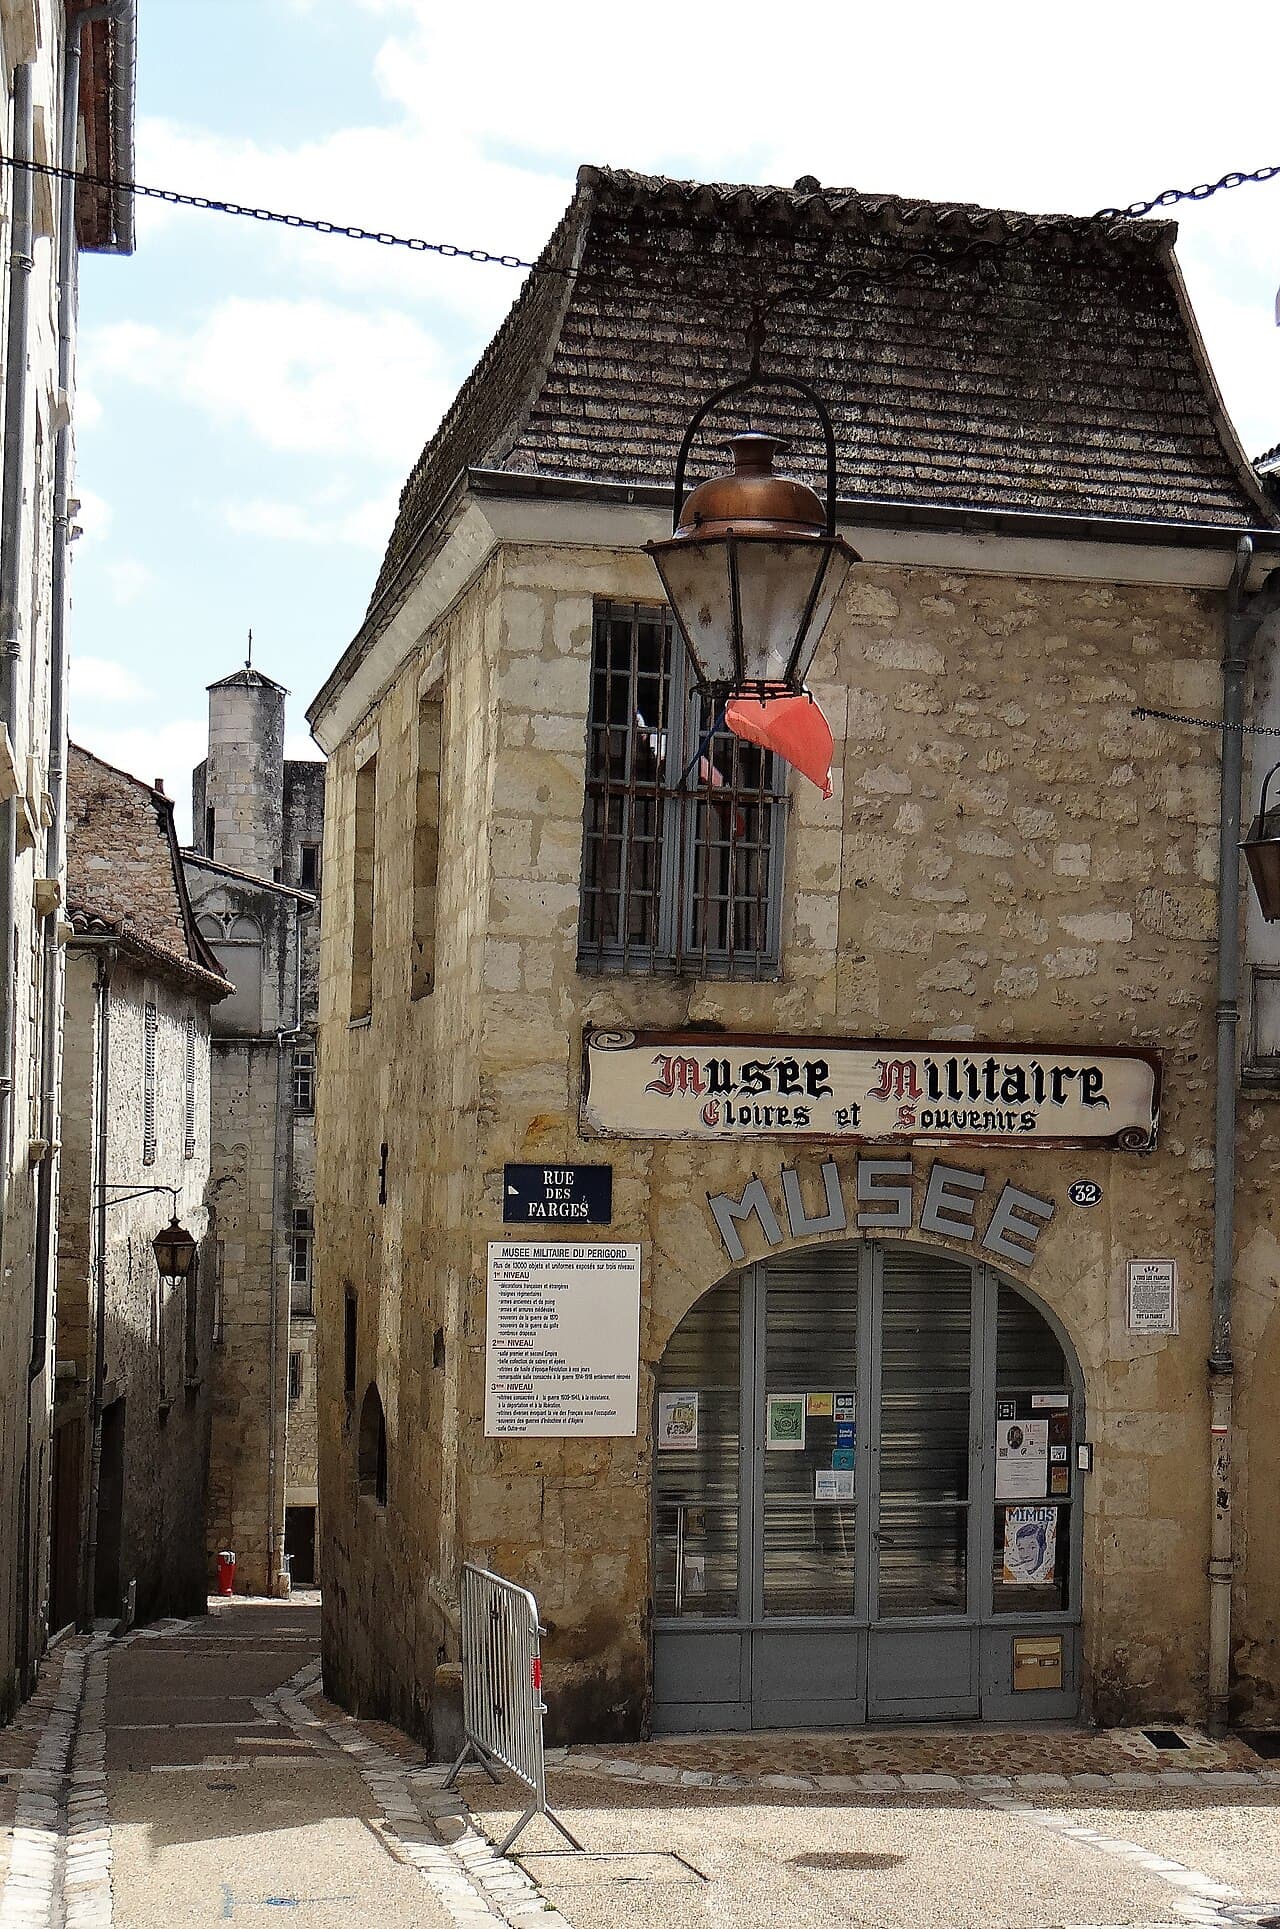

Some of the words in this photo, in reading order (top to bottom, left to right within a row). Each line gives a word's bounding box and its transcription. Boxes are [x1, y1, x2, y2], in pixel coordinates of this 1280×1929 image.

[645, 1053, 833, 1099] Musée
[866, 1057, 1110, 1110] Militaire
[835, 1102, 861, 1128] et
[892, 1104, 1039, 1132] Souvenirs
[543, 1170, 575, 1185] RUE
[545, 1188, 571, 1200] DES
[1074, 1184, 1098, 1203] 32
[528, 1202, 589, 1217] FARGES
[708, 1160, 1055, 1266] MUSEE
[501, 1248, 530, 1257] MUSEE
[533, 1249, 570, 1258] MILITAIRE
[573, 1249, 585, 1258] DU
[588, 1249, 627, 1258] PERIGORD
[503, 1271, 530, 1279] NIVEAU
[507, 1339, 534, 1347] NIVEAU
[506, 1383, 534, 1391] NIVEAU
[1008, 1509, 1055, 1522] MIMOS
